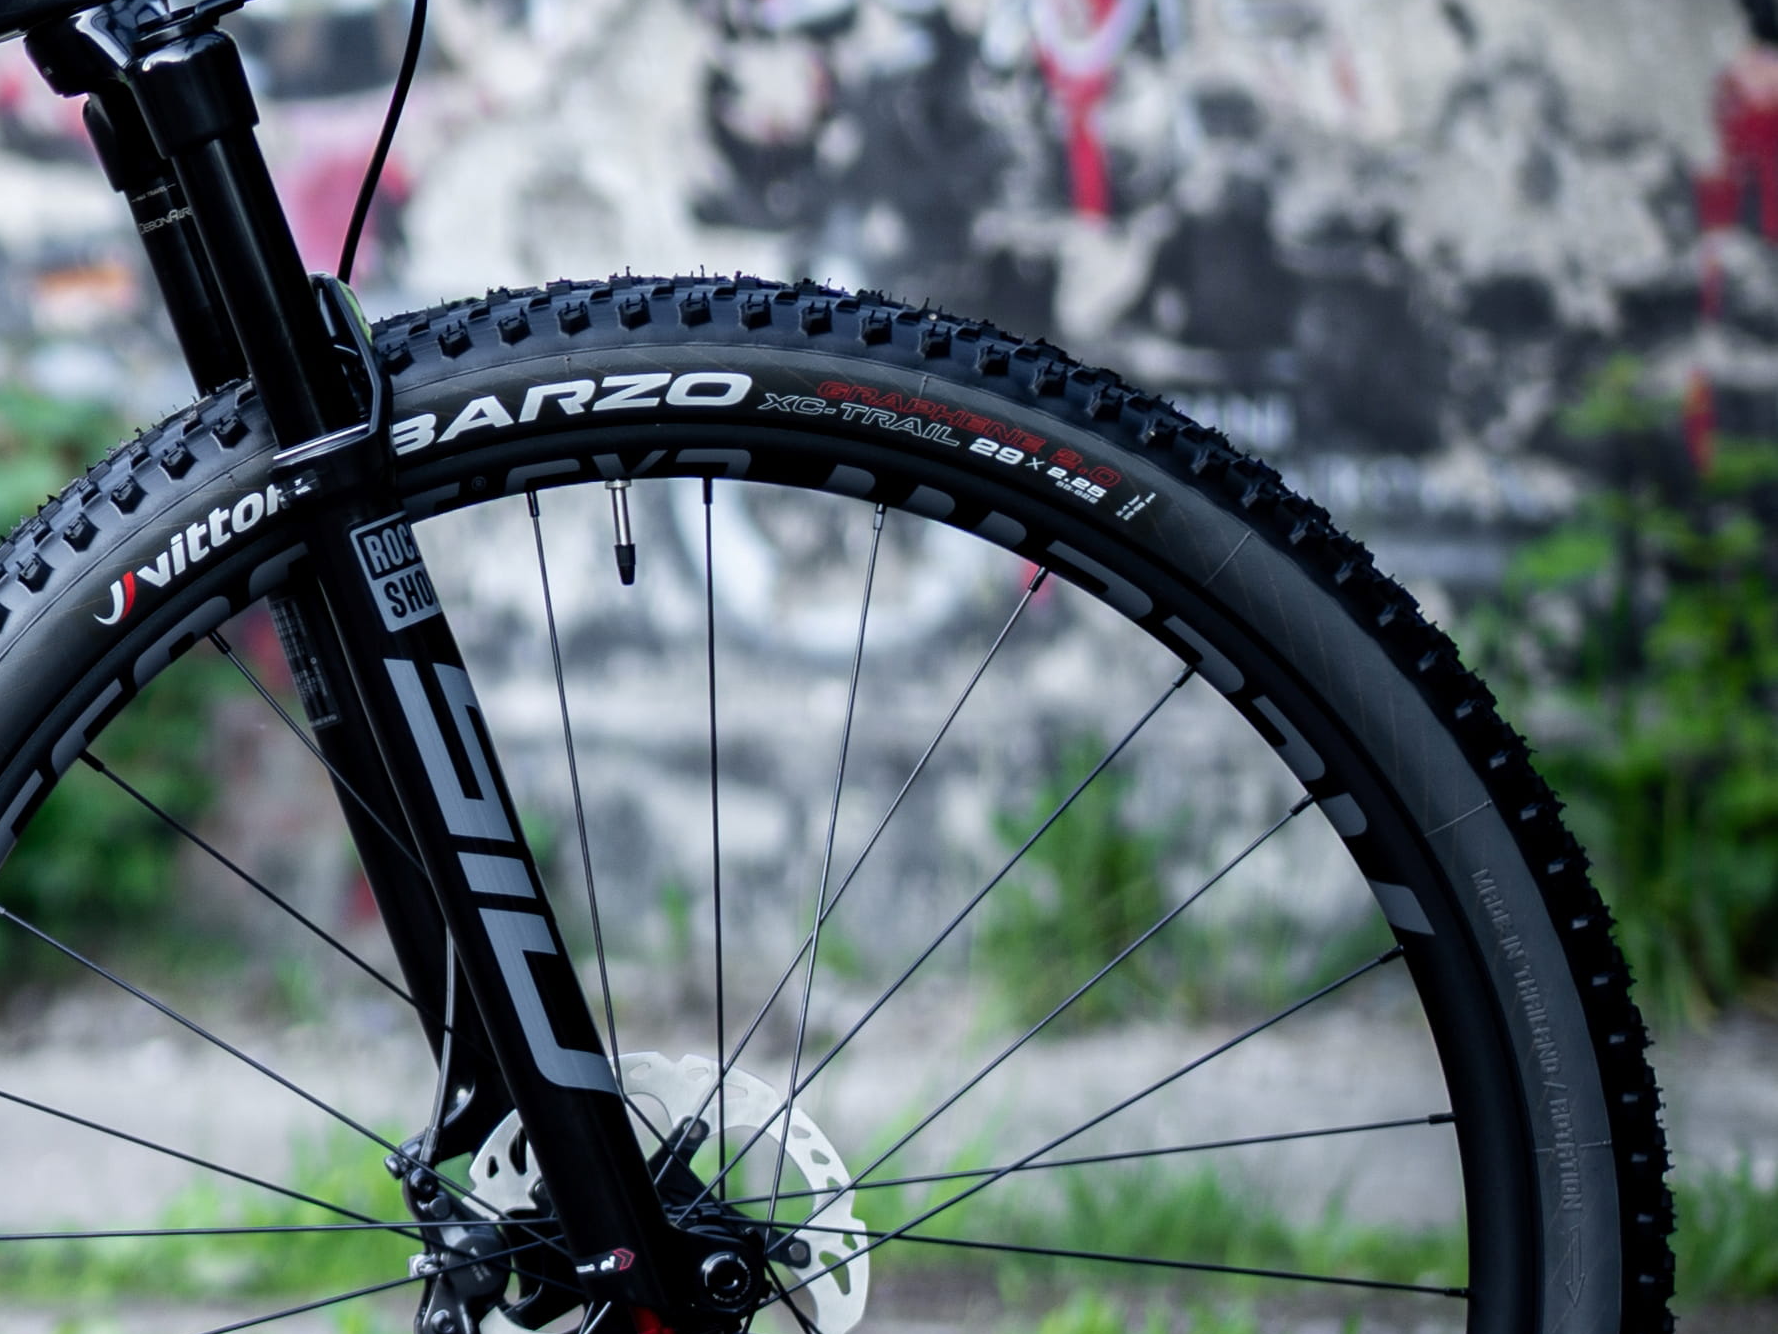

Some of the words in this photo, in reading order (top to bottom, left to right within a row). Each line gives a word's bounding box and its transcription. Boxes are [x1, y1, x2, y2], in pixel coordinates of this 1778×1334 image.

[757, 392, 960, 449] XC-TRAIL
[968, 436, 1025, 466] 29
[1048, 466, 1107, 498] 2.25
[815, 380, 1045, 454] GRAPHENE
[133, 482, 286, 588] vittor
[392, 372, 753, 457] BARZO
[364, 522, 422, 574] ROC
[383, 572, 435, 619] SHO
